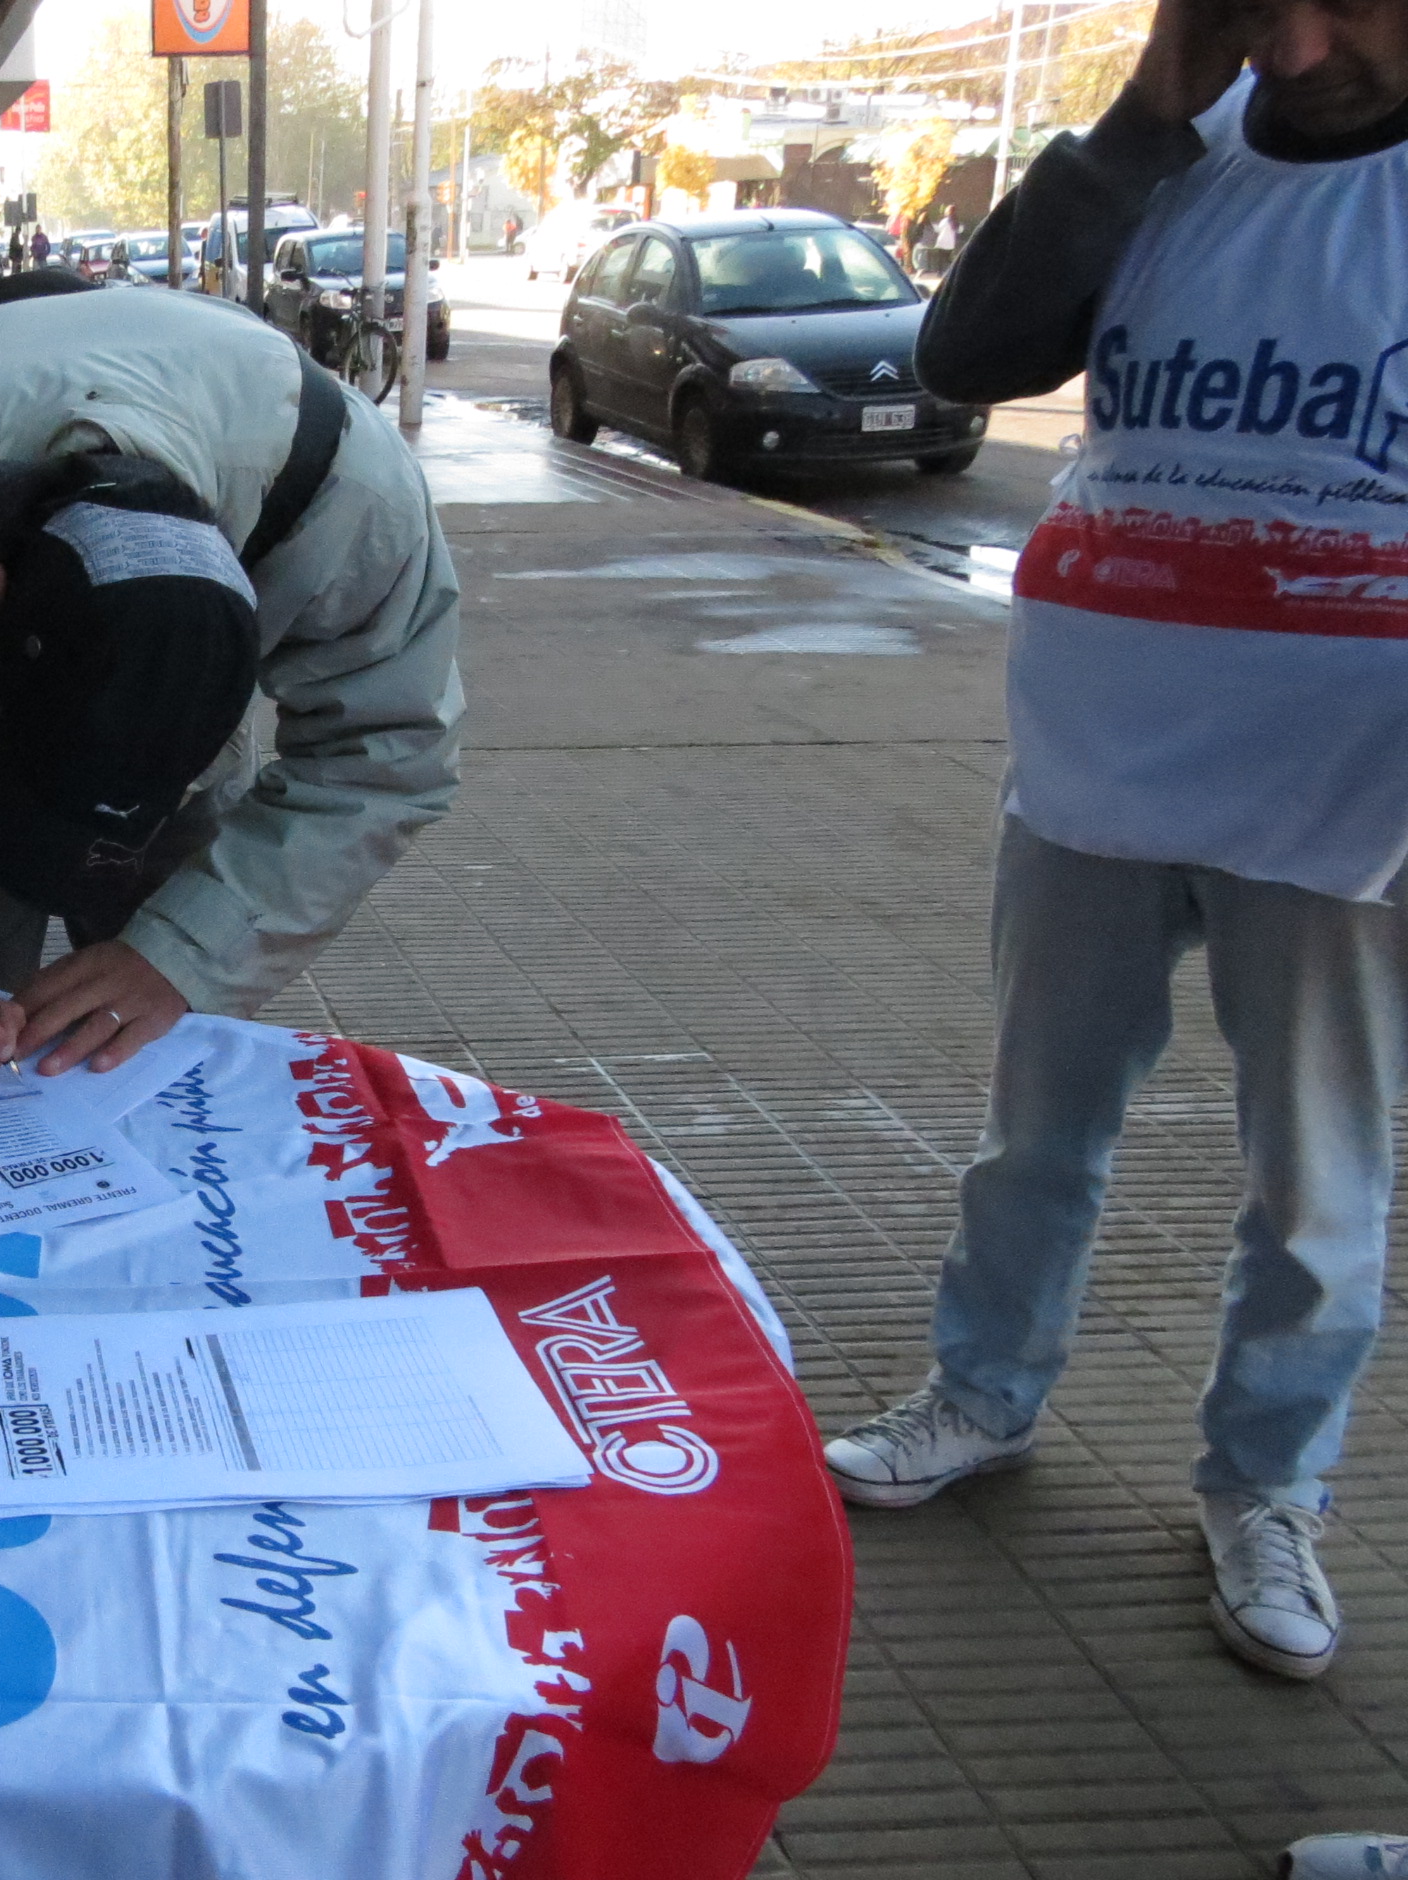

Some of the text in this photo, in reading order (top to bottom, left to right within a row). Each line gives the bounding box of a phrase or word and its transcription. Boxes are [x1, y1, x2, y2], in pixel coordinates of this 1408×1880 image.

[1093, 324, 1361, 439] Suteba
[2, 1159, 33, 1172] FIRMAS
[9, 1151, 104, 1182] 1.000.000
[42, 1194, 94, 1213] GREMIAL
[96, 1186, 137, 1202] FRENTE
[2, 1357, 13, 1379] IOMA
[518, 1275, 719, 1495] CTERA
[39, 1407, 57, 1430] FIRMAS
[8, 1409, 53, 1473] 1.000.000
[213, 1501, 359, 1640] defen
[281, 1663, 350, 1740] en
